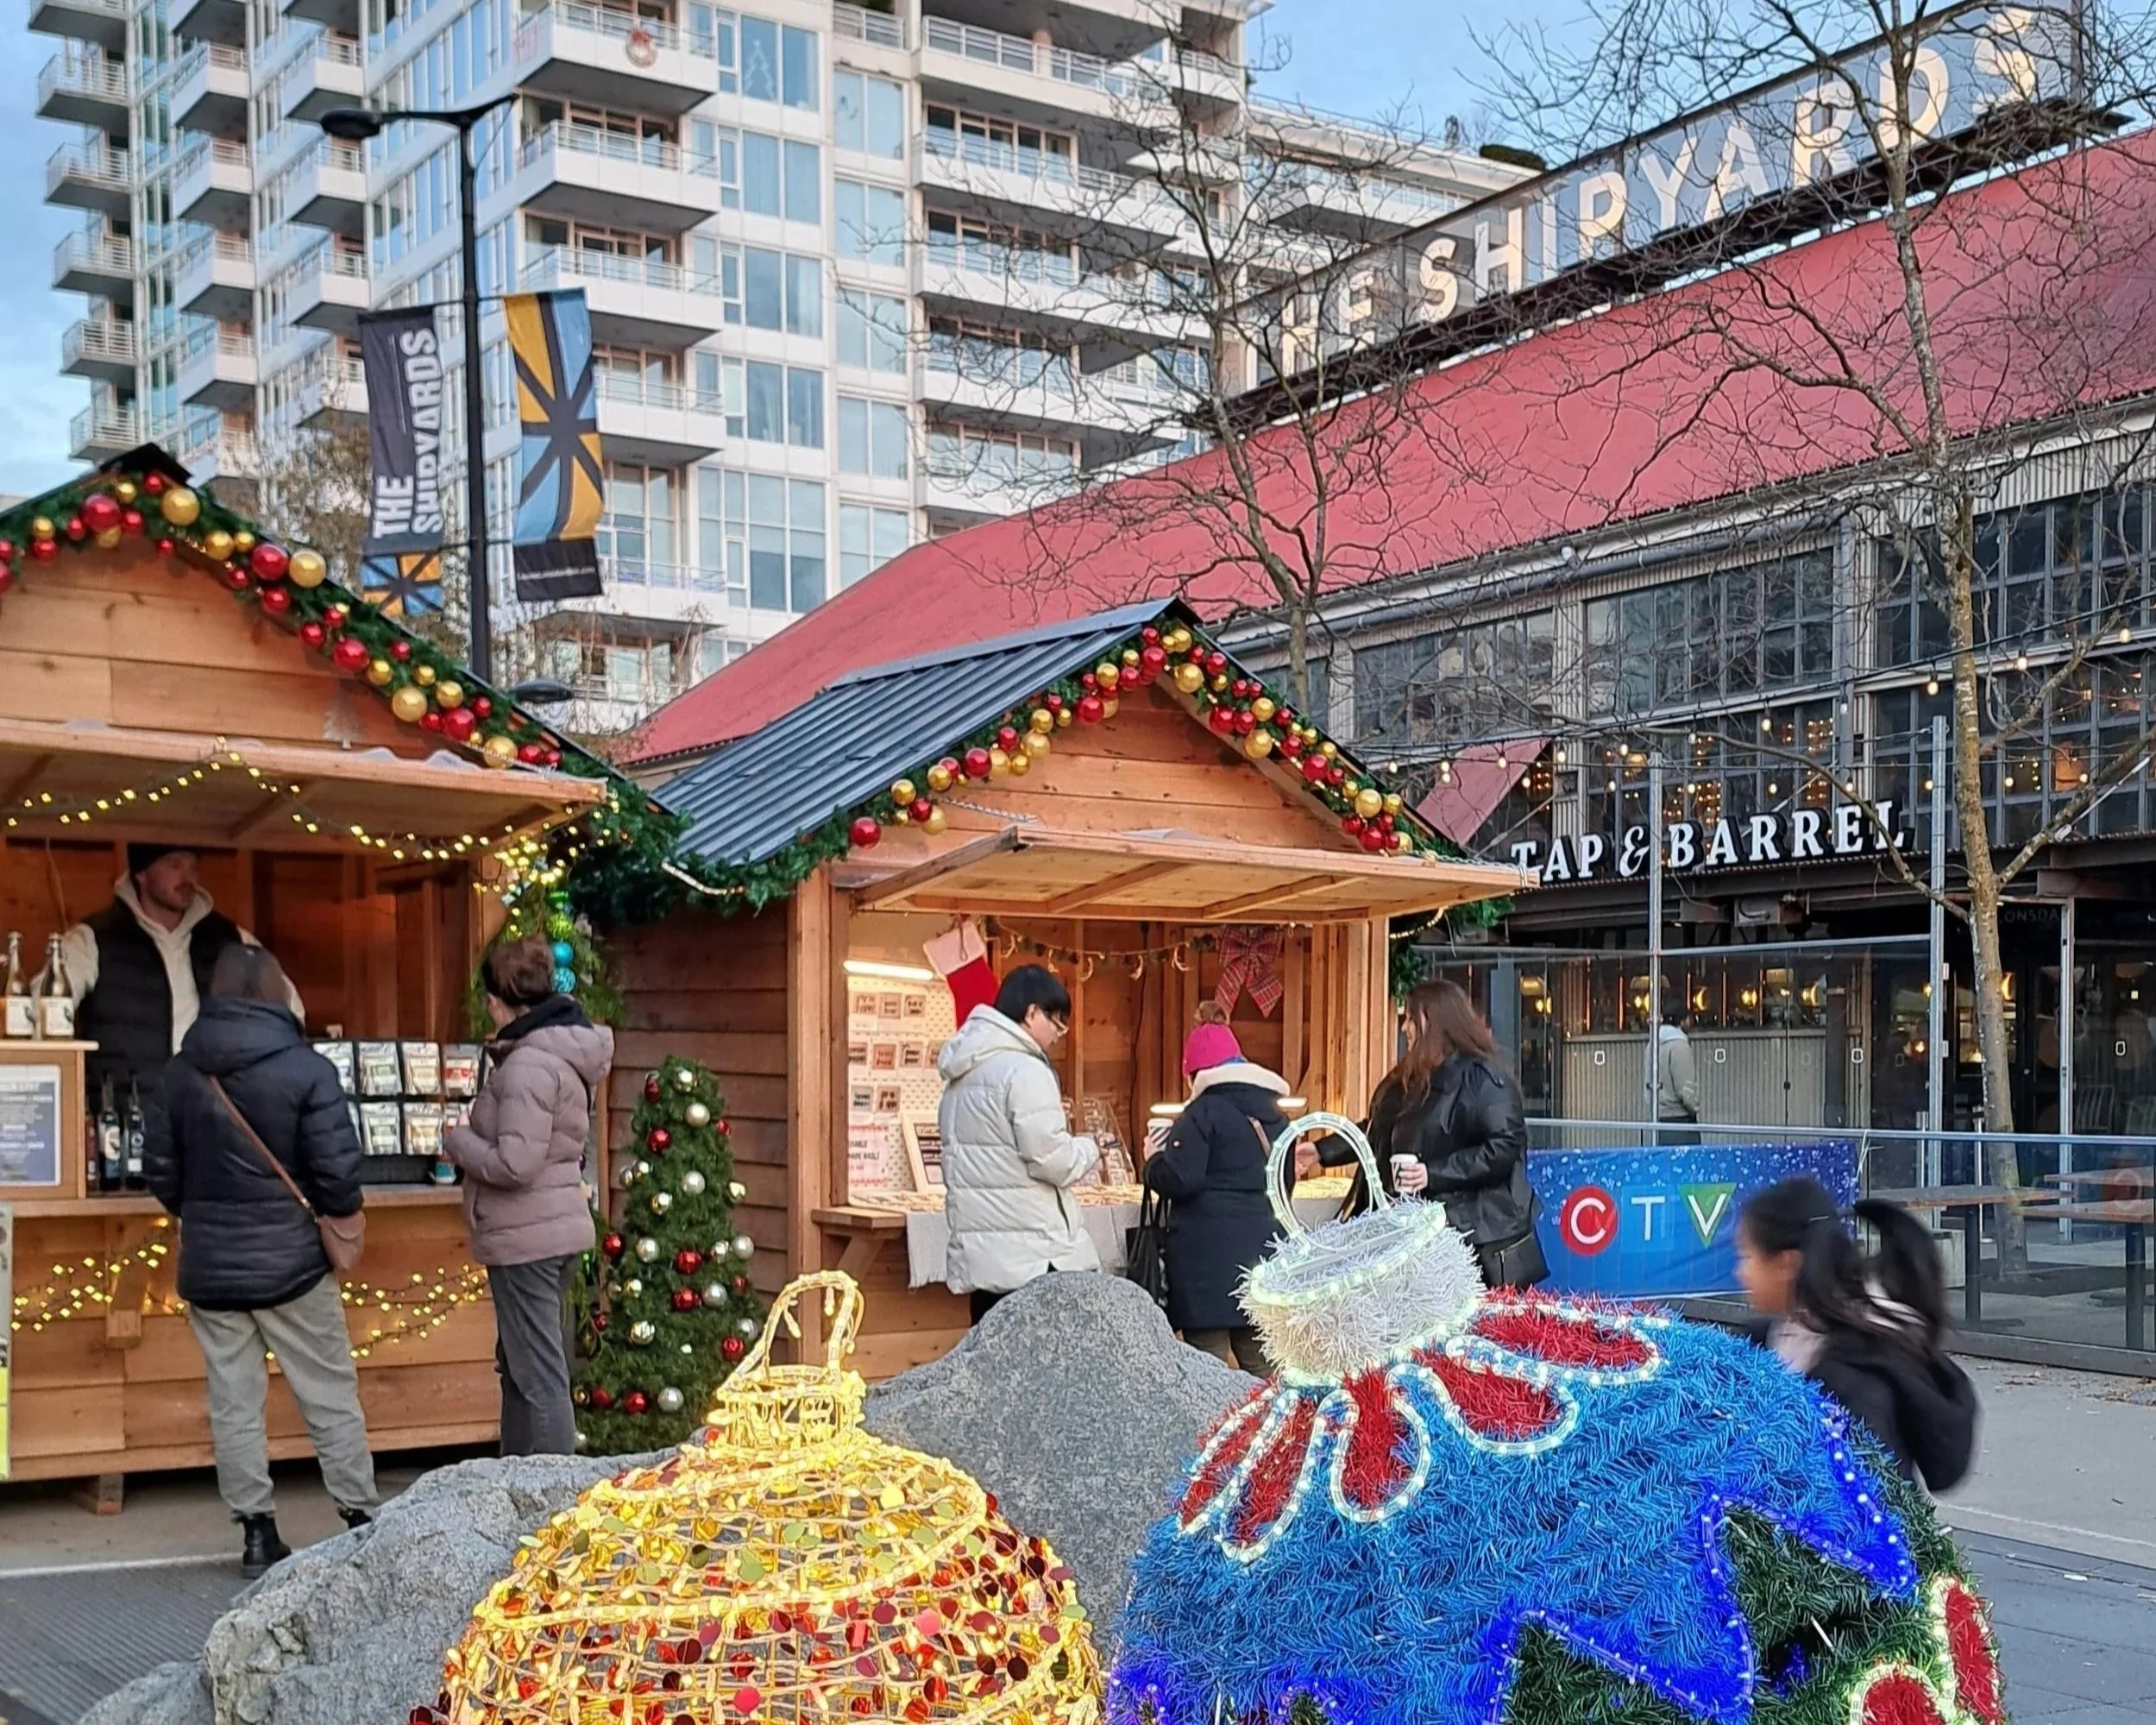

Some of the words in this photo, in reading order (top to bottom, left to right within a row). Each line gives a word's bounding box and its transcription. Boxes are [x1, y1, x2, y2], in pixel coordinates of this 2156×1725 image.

[1418, 8, 2037, 323] SHIPYARDS
[399, 327, 443, 534] SHIPYARDS
[373, 475, 414, 538] THE
[1511, 834, 1605, 882] TAP
[1619, 825, 1650, 878] &
[1668, 800, 1905, 868] BARREL
[1999, 908, 2059, 924] ONSDA
[1569, 1193, 1728, 1245] CTV
